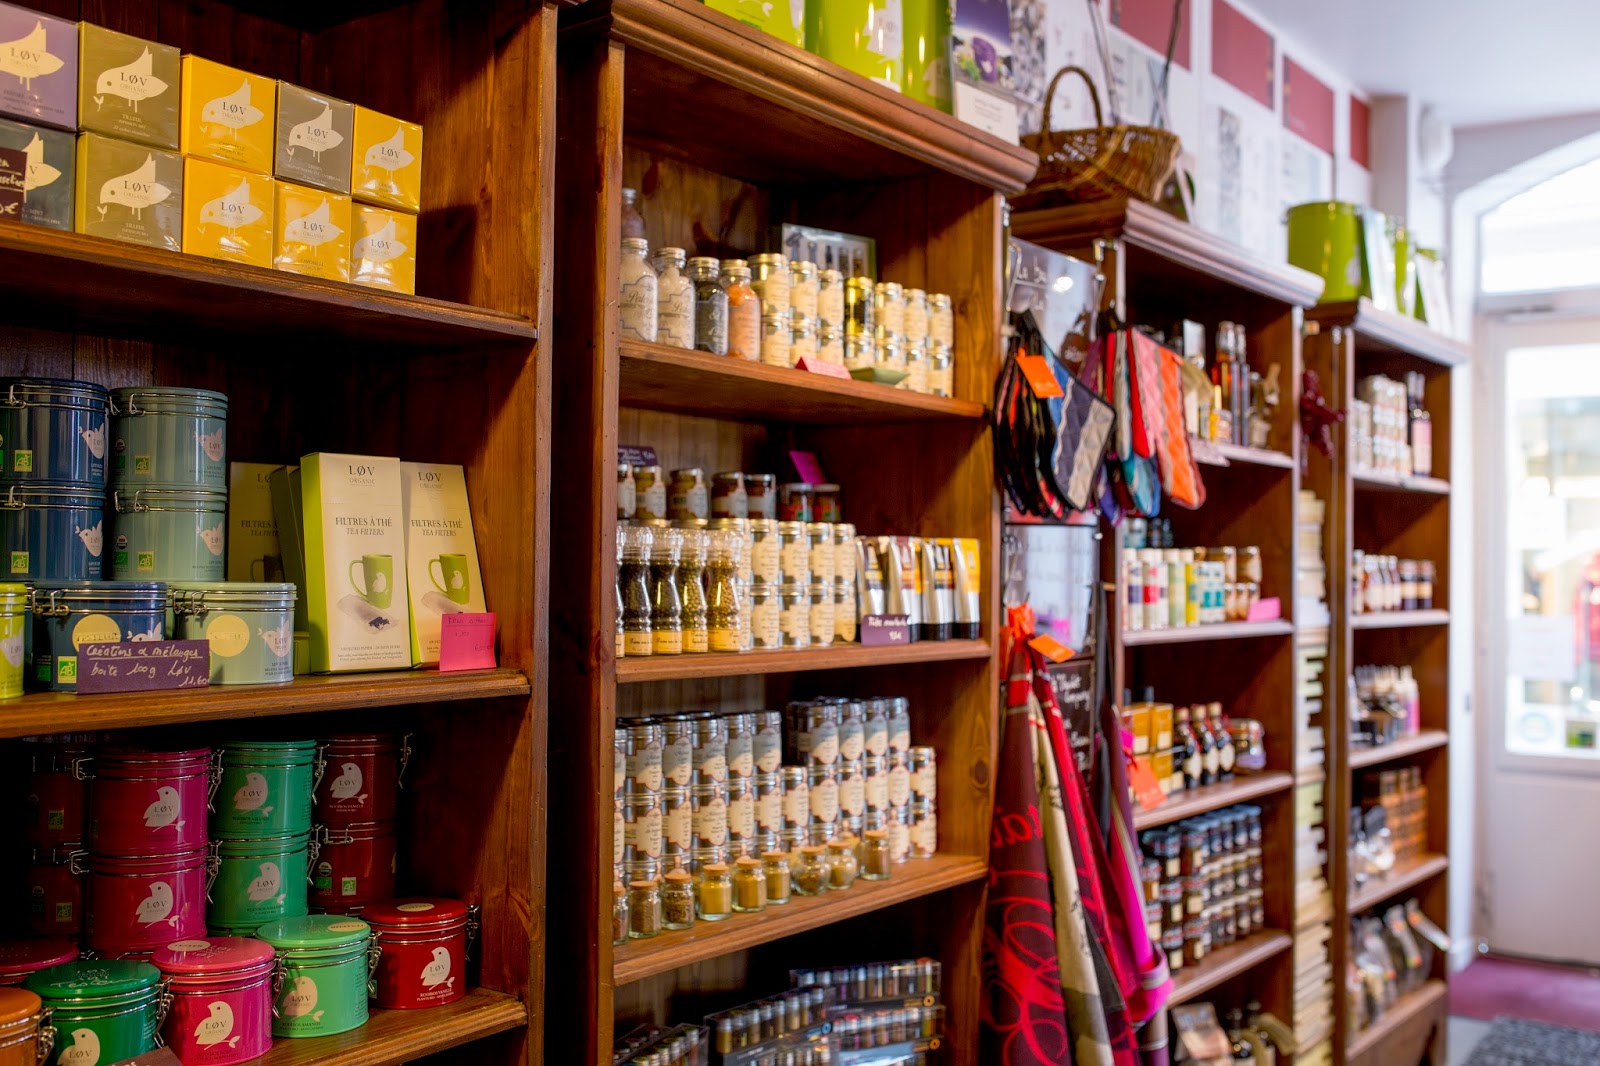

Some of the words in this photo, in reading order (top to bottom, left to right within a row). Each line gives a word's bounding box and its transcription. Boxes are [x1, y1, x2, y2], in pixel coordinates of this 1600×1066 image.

[10, 47, 41, 63] LØV
[120, 72, 148, 87] LØV
[222, 101, 247, 115] LØV
[307, 126, 329, 139] LØV
[381, 146, 401, 159] LØV
[123, 179, 151, 194] LØV
[220, 201, 246, 215] LØV
[303, 221, 326, 233] LØV
[371, 239, 392, 250] LØV
[348, 465, 375, 476] LØV
[418, 472, 442, 482] LØV
[335, 517, 368, 527] FILTRES
[376, 515, 393, 527] THÉ
[411, 519, 441, 528] FILTRES
[360, 528, 385, 536] FILTERS
[178, 676, 210, 687] 11,60
[154, 805, 174, 813] LØV
[257, 879, 275, 887] LØV
[146, 900, 167, 909] LØV
[429, 963, 447, 972] LØV
[291, 994, 311, 1002] LØV
[205, 1020, 228, 1030] LØV
[69, 1050, 93, 1059] LØV
